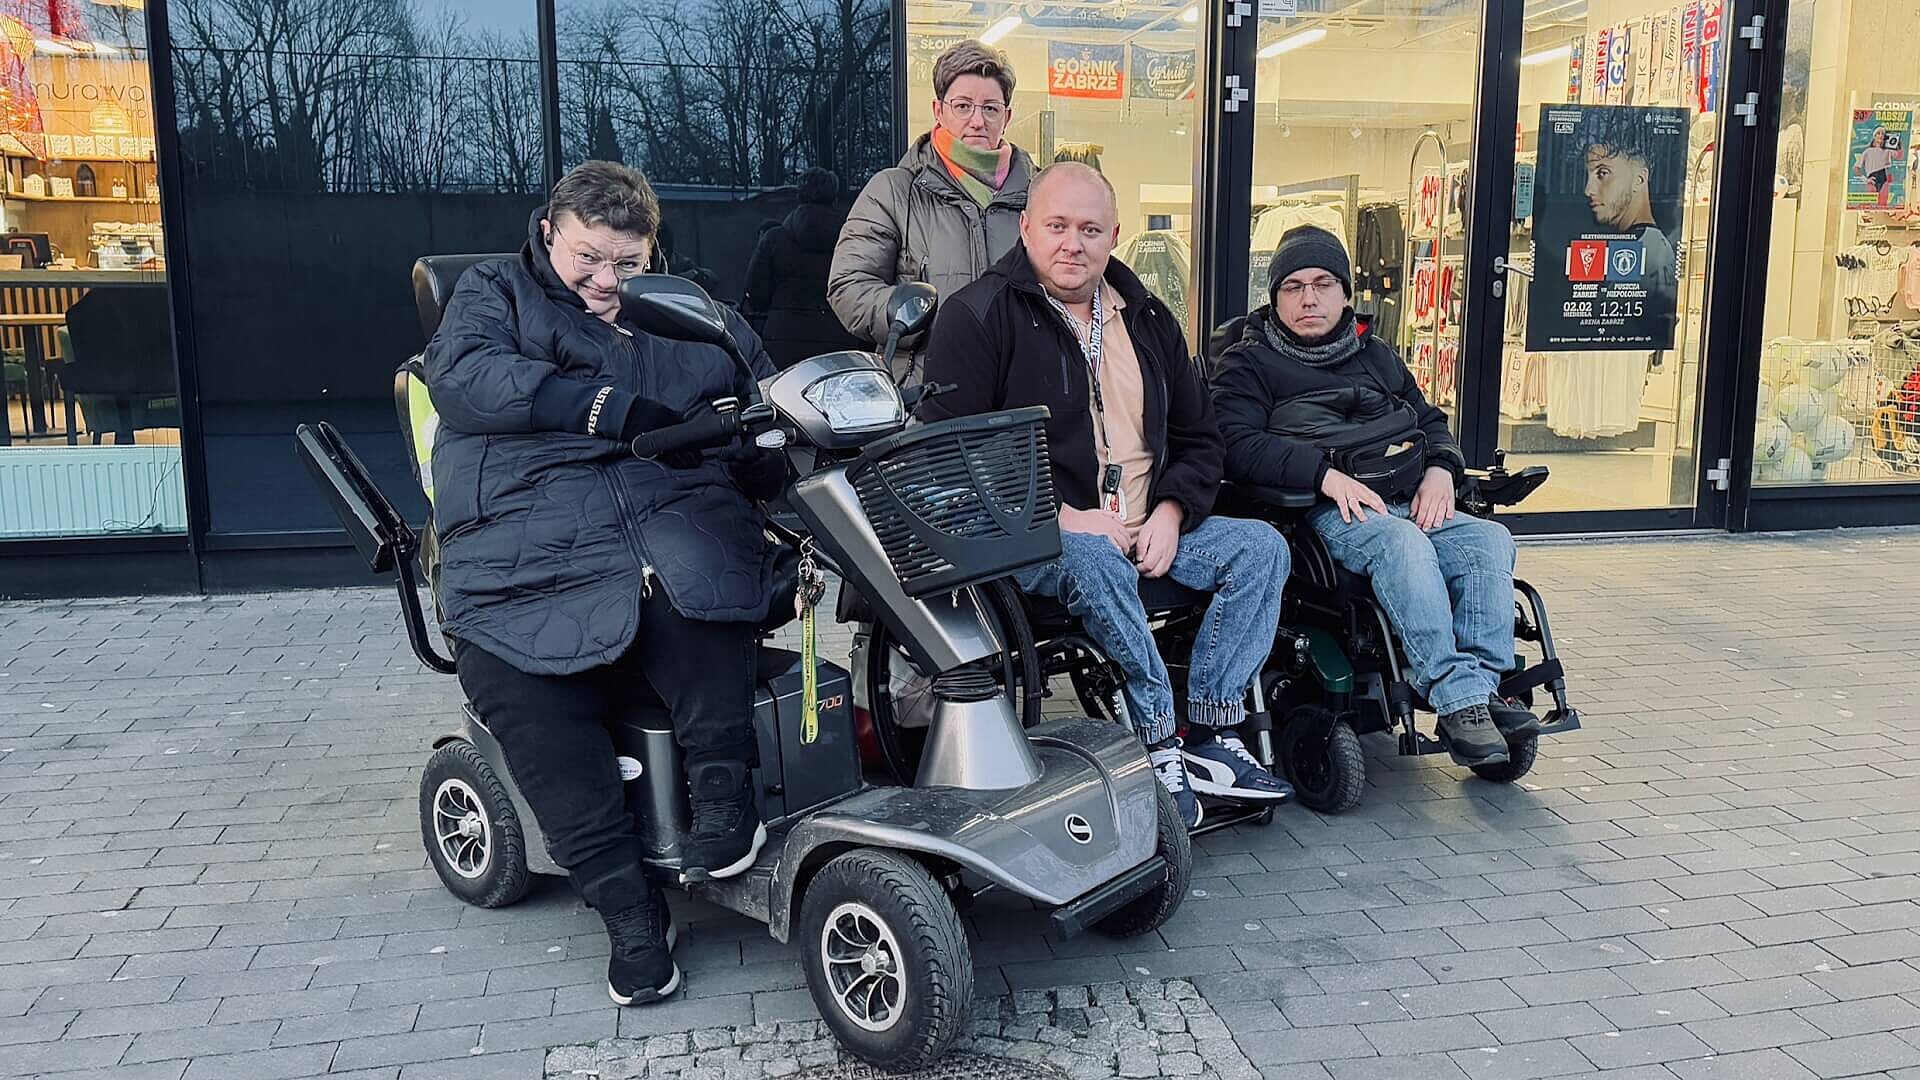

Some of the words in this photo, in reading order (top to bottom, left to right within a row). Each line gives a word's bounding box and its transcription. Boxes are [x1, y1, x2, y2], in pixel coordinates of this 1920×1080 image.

[1054, 57, 1120, 76] GÓRNIK
[1053, 74, 1118, 91] ZABRZE
[1563, 301, 1593, 312] 02.02
[1599, 301, 1644, 317] 12:15
[817, 695, 844, 711] 700
